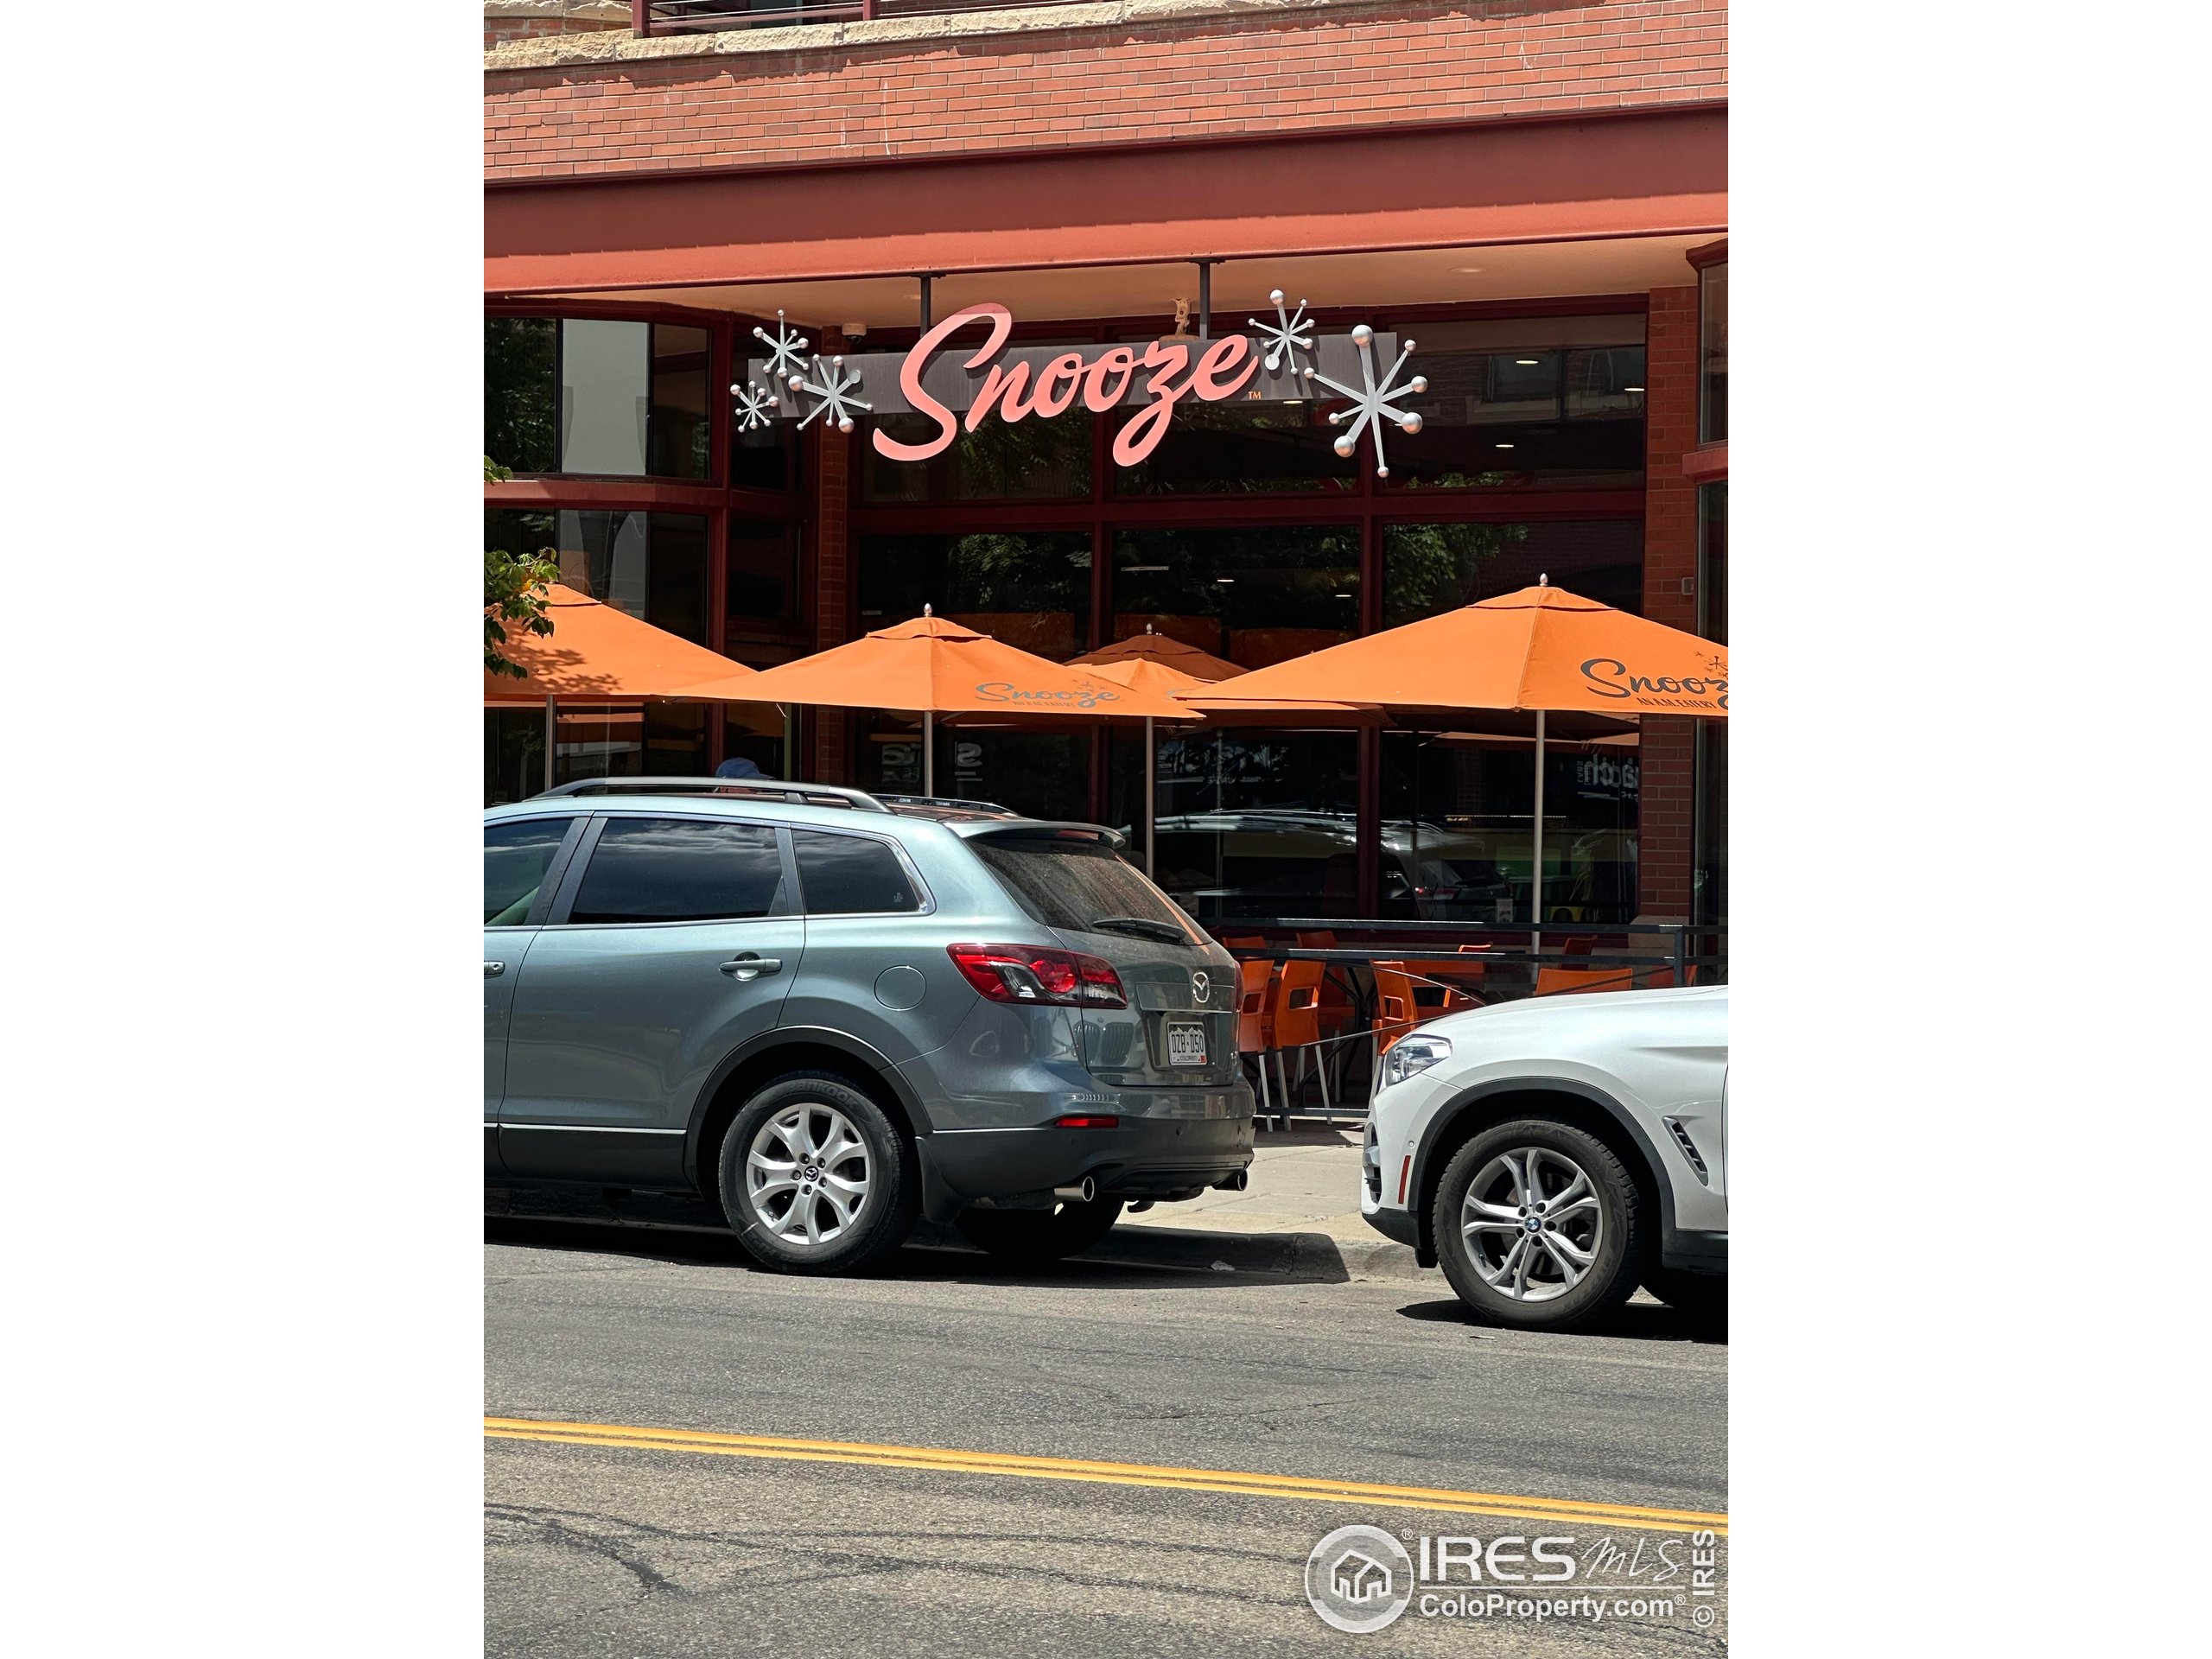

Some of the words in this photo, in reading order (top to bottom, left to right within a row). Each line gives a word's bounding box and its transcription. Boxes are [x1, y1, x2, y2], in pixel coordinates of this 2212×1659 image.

[873, 302, 1259, 467] Snooze
[1248, 391, 1262, 400] TM
[975, 682, 1120, 709] Snooze
[1637, 697, 1655, 706] AN
[1675, 699, 1717, 709] EATERY
